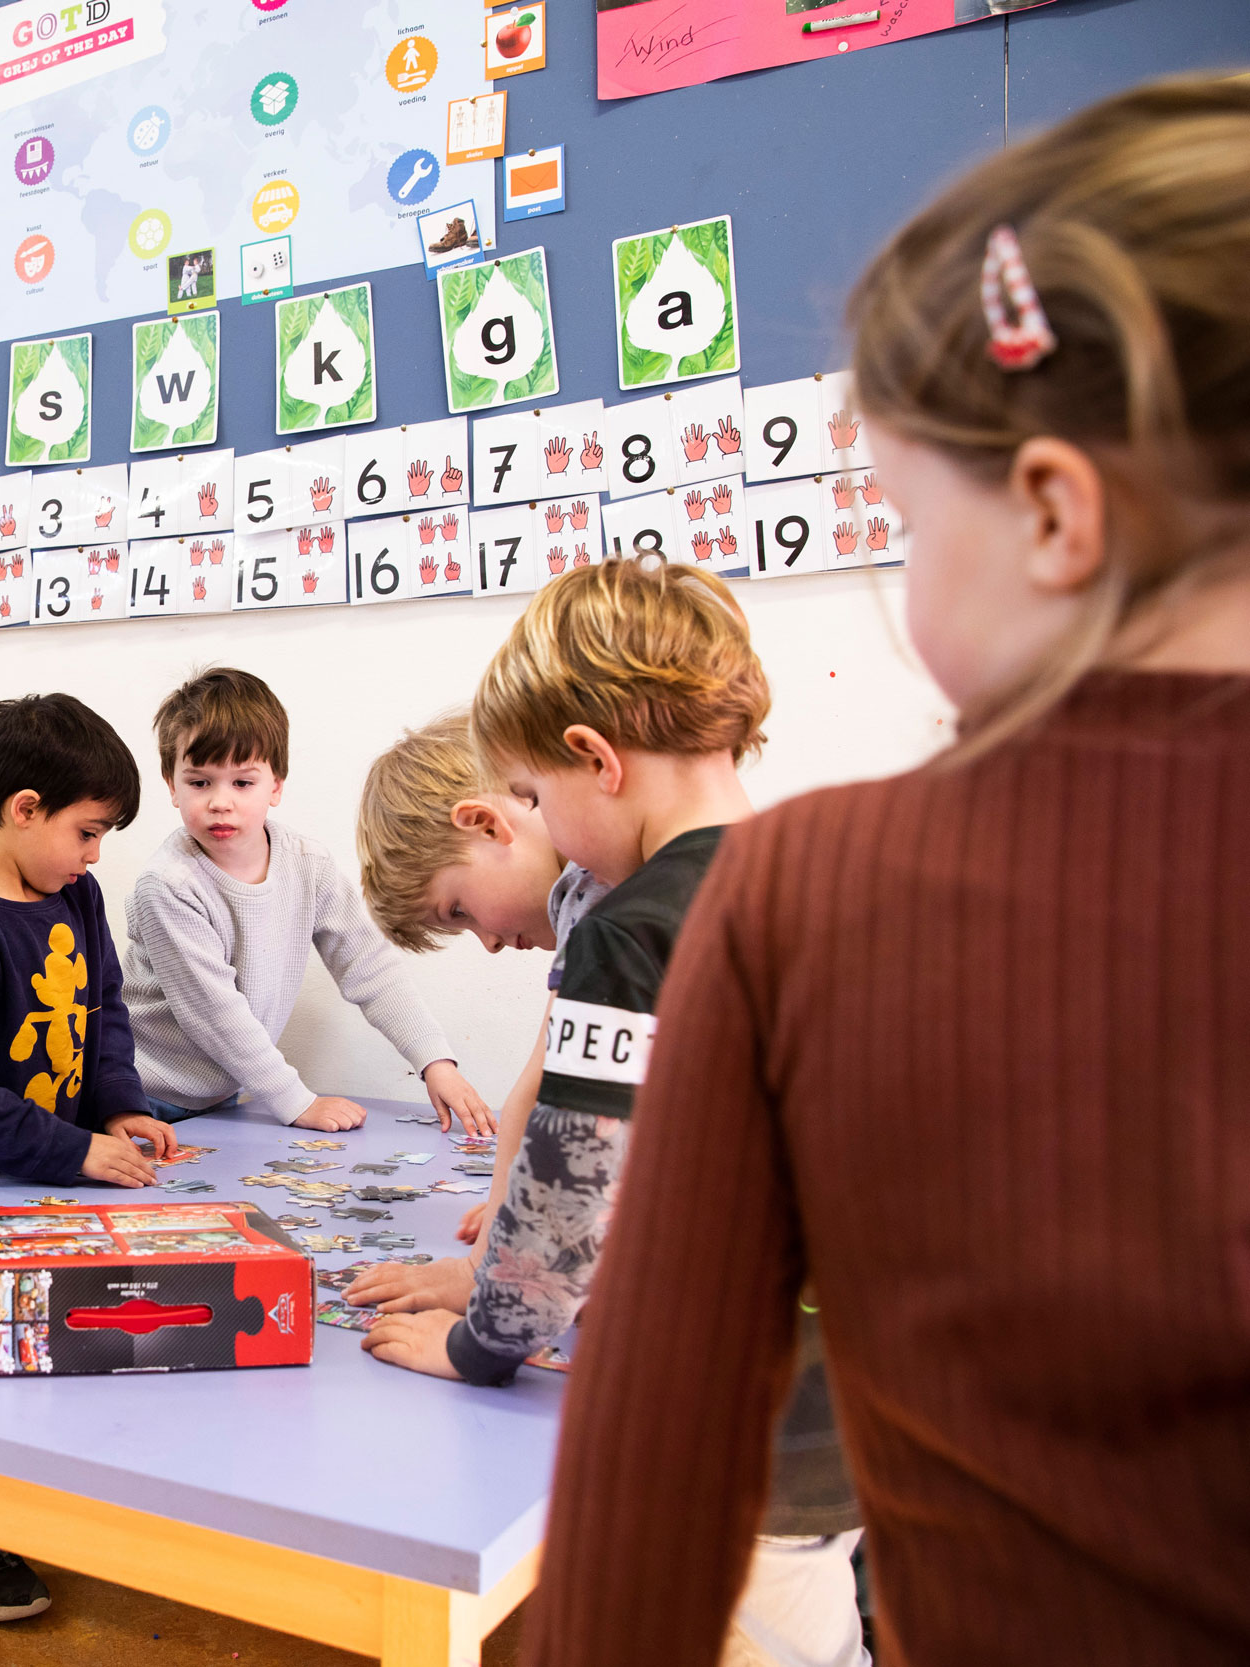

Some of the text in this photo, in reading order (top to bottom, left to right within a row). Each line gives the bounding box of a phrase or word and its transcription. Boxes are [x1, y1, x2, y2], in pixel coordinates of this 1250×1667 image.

[12, 0, 111, 47] GOTD
[258, 12, 289, 26] personen
[397, 23, 425, 36] lichaam
[630, 25, 694, 57] Wind
[3, 26, 129, 79] GREJ OF THE DAY
[505, 63, 525, 74] appel
[398, 94, 427, 108] voeding
[14, 123, 55, 140] gebeurtenissen
[265, 127, 286, 139] overig
[139, 158, 160, 169] natuur
[263, 168, 289, 179] verkeer
[19, 186, 51, 199] feestdagen
[397, 207, 431, 220] beroepen
[527, 205, 542, 215] post
[26, 223, 43, 233] kunst
[143, 262, 159, 273] sport
[25, 286, 45, 297] cultuur
[657, 290, 694, 330] a
[480, 315, 517, 366] g
[313, 341, 344, 385] k
[156, 369, 196, 404] w
[39, 390, 63, 422] s
[38, 498, 63, 538] 3
[137, 487, 166, 528] 4
[246, 479, 274, 524] 5
[357, 458, 387, 505] 6
[489, 443, 518, 494] 7
[621, 433, 656, 484] 8
[763, 415, 798, 468] 9
[34, 576, 71, 619] 13
[129, 565, 170, 608] 14
[236, 556, 279, 604] 15
[354, 547, 400, 599] 16
[479, 535, 523, 590] 17
[755, 515, 810, 572] 19
